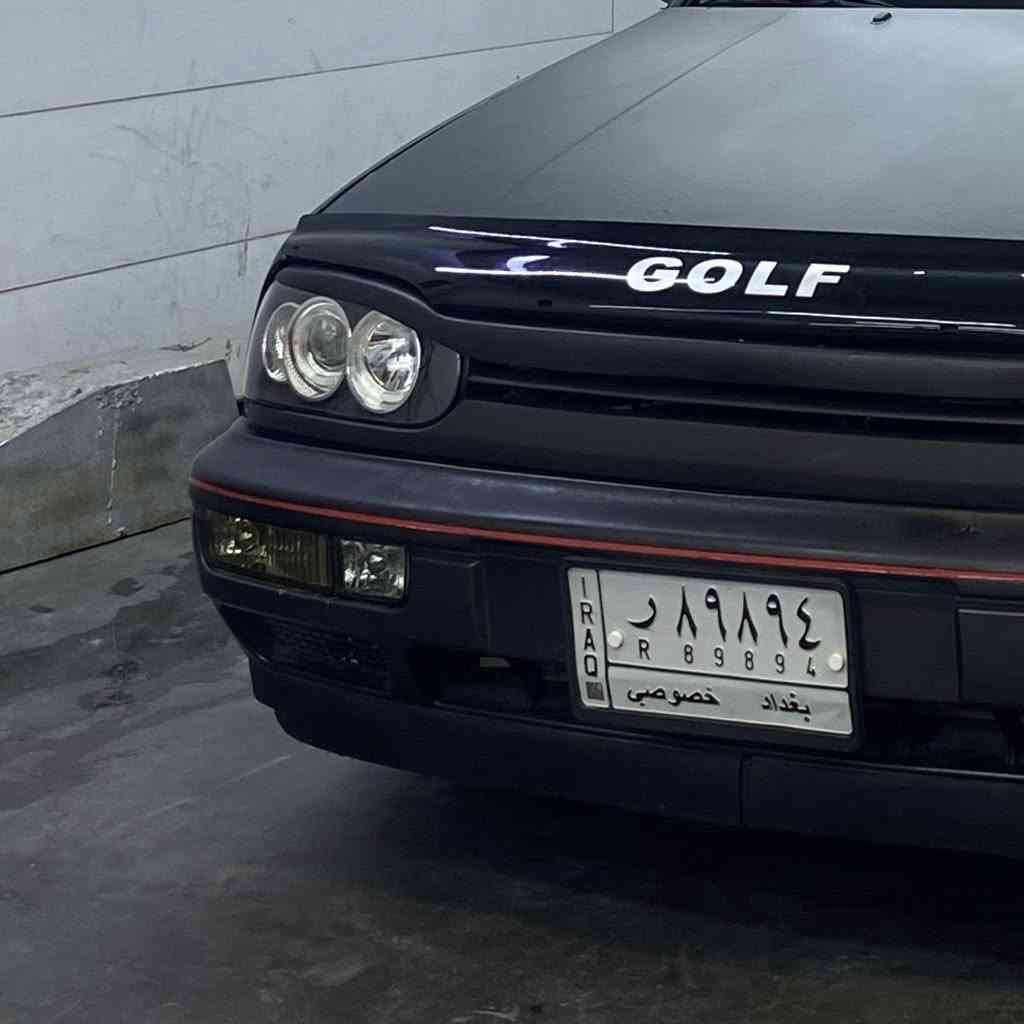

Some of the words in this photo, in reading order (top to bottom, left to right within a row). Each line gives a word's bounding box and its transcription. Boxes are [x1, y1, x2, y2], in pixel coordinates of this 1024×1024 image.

[625, 256, 851, 298] GOLF
[578, 576, 599, 677] IRAQ
[638, 639, 650, 660] R
[628, 686, 720, 707] خصوصي
[761, 691, 812, 723] بغداد
